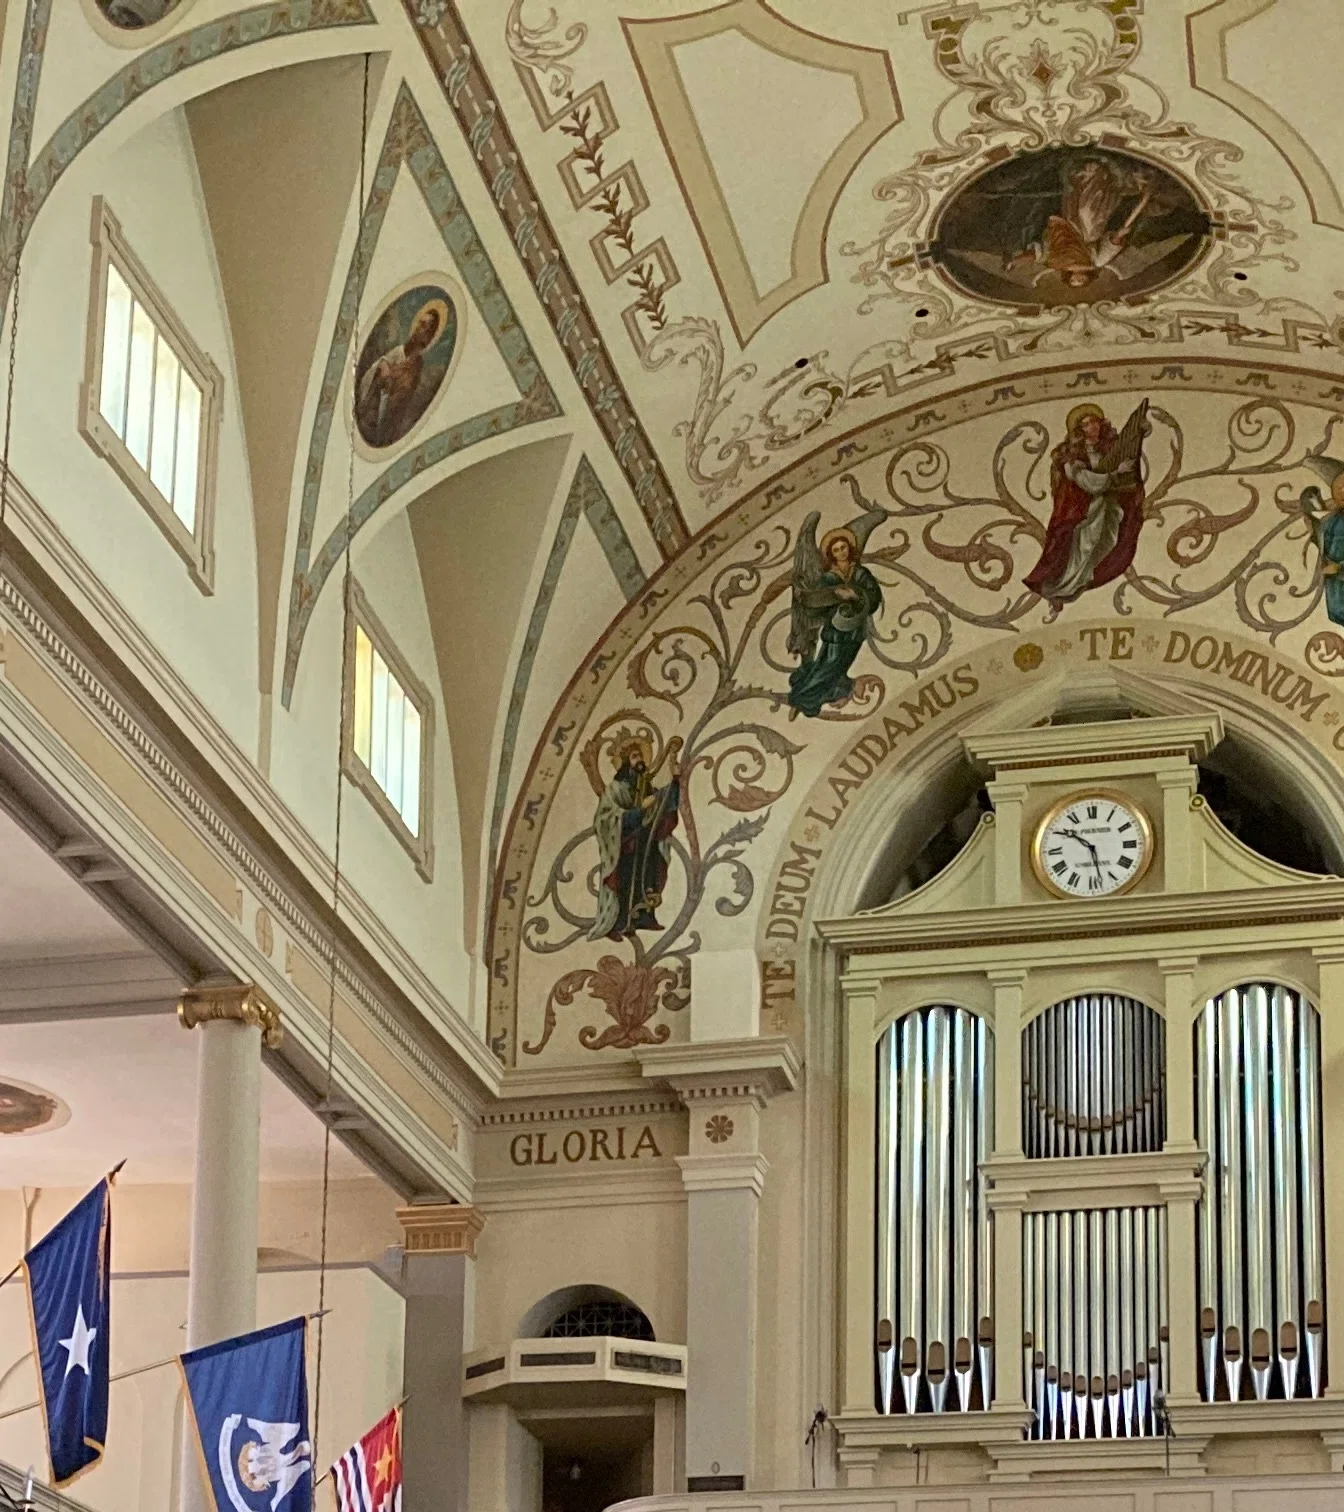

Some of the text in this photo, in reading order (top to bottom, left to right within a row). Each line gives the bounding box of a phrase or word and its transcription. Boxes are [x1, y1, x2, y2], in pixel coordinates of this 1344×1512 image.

[1079, 626, 1136, 661] TE
[1162, 630, 1331, 723] DOMINUM
[805, 663, 980, 831] LAUDAMUS
[765, 841, 824, 943] DEUM
[761, 960, 796, 1009] TE
[509, 1125, 663, 1167] GLORIA
